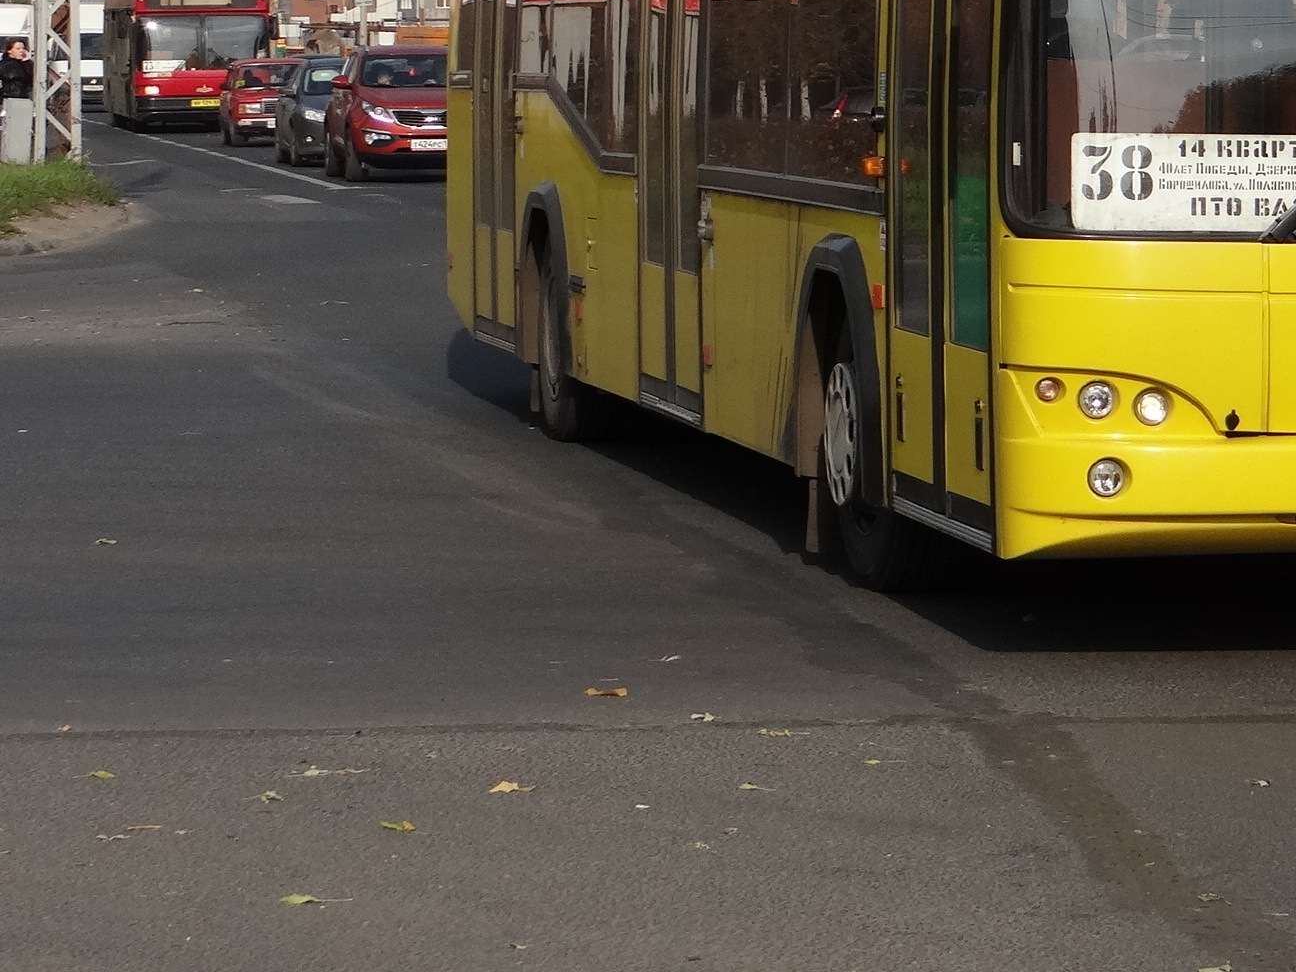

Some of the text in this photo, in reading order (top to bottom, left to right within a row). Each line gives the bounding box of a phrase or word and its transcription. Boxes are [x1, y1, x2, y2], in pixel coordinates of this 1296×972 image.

[1178, 139, 1206, 158] 14
[1081, 144, 1154, 201] 38
[1190, 196, 1242, 217] ПТО
